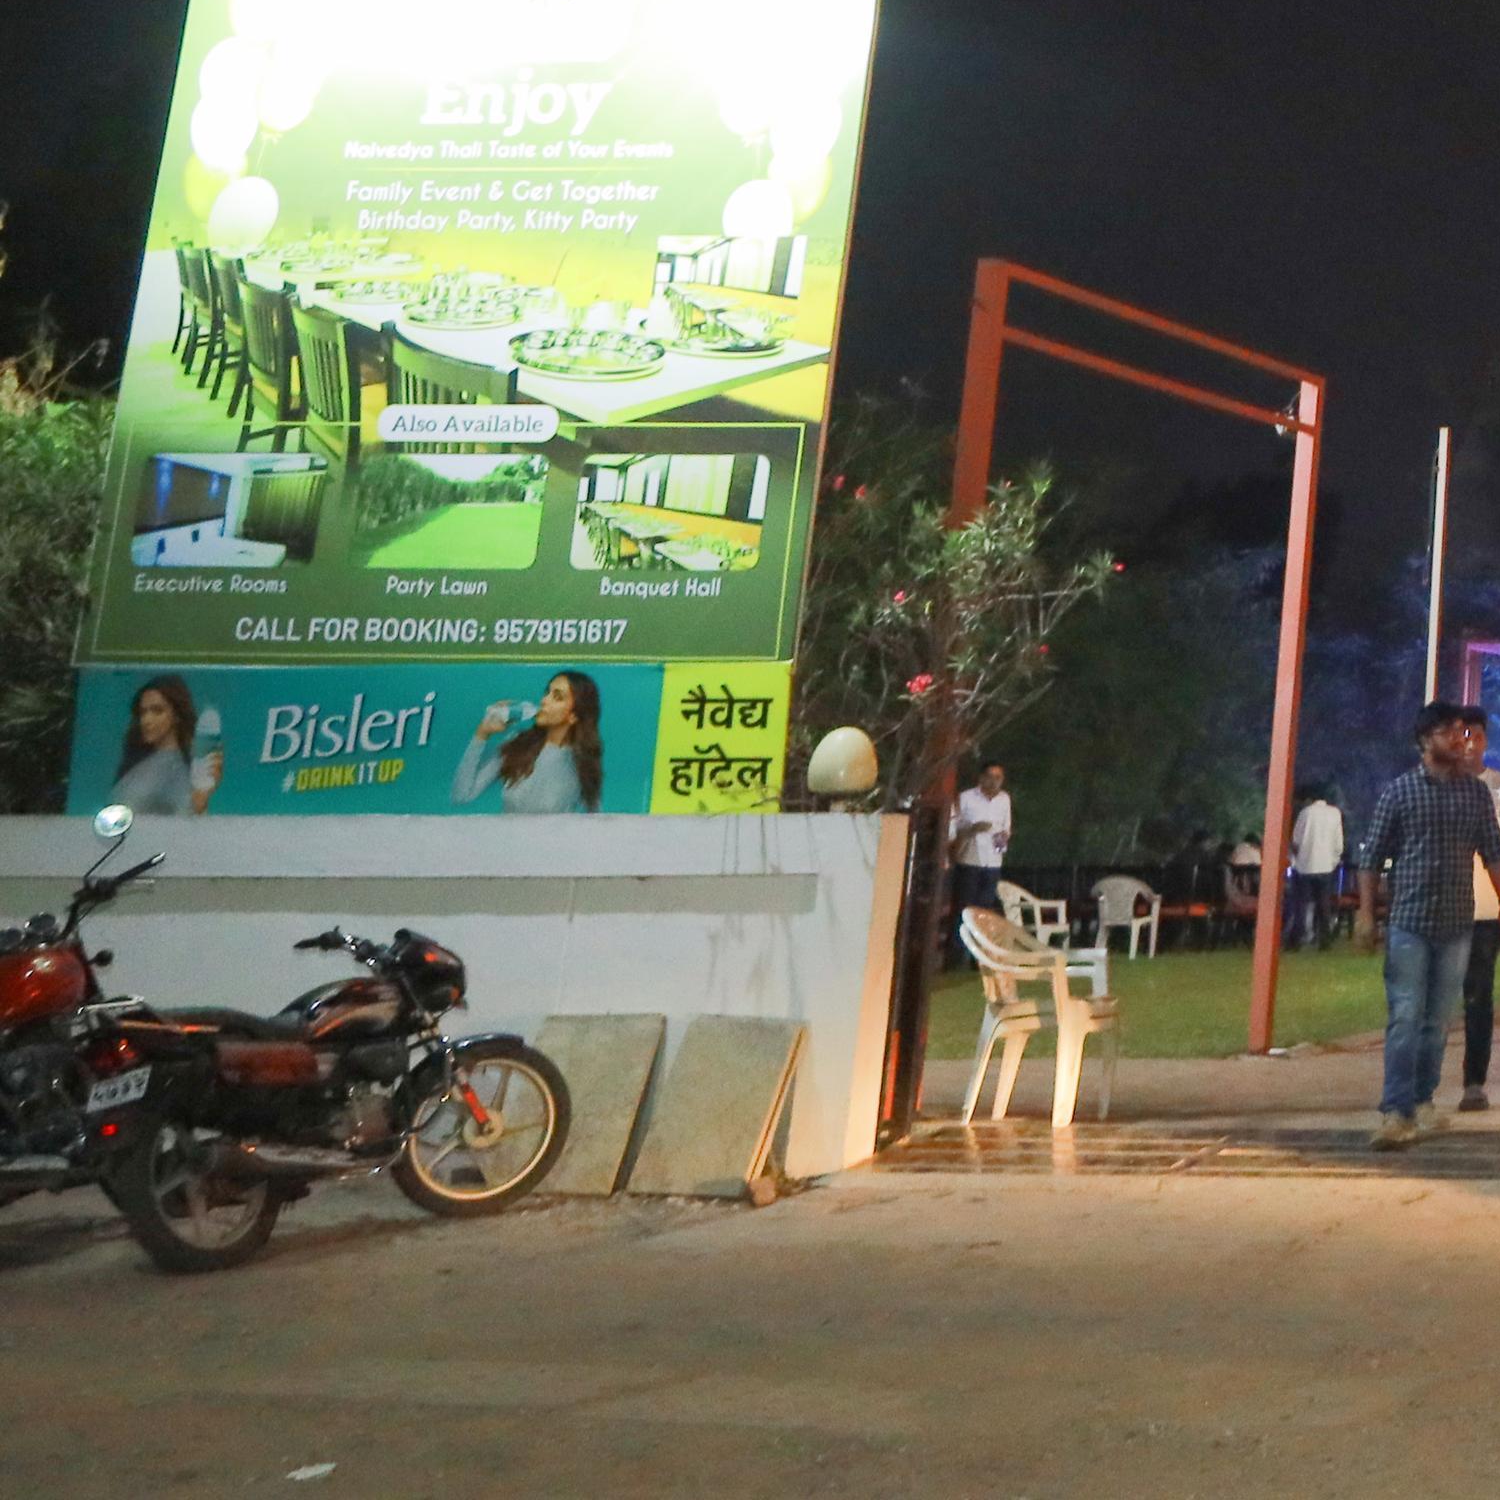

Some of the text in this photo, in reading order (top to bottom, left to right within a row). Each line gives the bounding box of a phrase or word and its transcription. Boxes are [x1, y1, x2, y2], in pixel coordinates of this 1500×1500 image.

[419, 67, 614, 137] Enjoy
[343, 138, 675, 162] Naivedya Thali Taste of Your Events
[346, 179, 661, 205] Family Event & Get Together
[357, 207, 639, 233] Birthday Party, Kitty Party
[391, 414, 544, 433] Also Available
[133, 573, 288, 593] Executive Rooms
[385, 575, 488, 598] Party Lawn
[599, 575, 722, 600] Banquet Hall
[234, 616, 629, 645] CALL FOR BOOKING: 9579151617
[680, 683, 774, 730] नैवेद्य
[259, 690, 437, 764] Bisleri
[668, 742, 773, 796] हॉटेल
